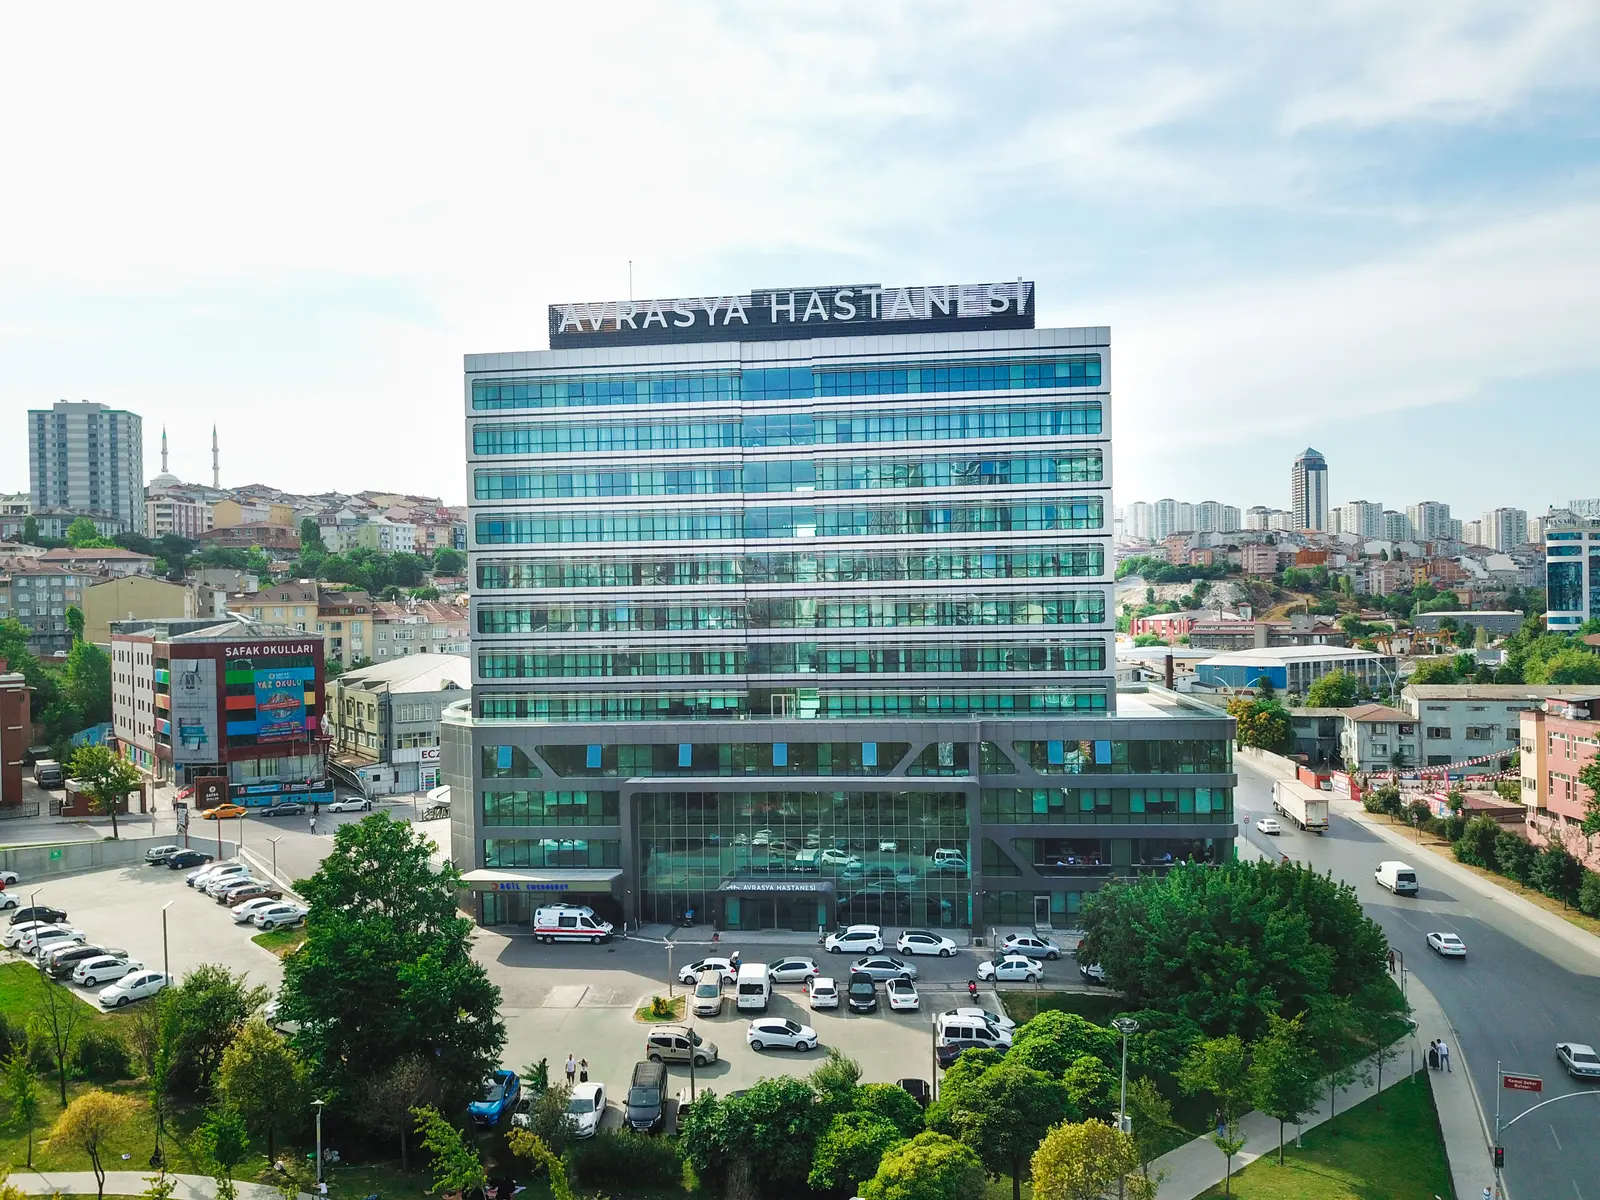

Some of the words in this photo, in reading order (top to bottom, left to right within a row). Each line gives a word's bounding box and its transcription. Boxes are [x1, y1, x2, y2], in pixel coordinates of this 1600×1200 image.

[559, 297, 749, 333] AVRASYA
[770, 277, 1025, 323] HASTANESİ
[225, 646, 260, 657] ŞAFAK
[263, 644, 313, 655] OKULLARI
[257, 681, 273, 689] YAZ
[275, 679, 302, 688] OKULU
